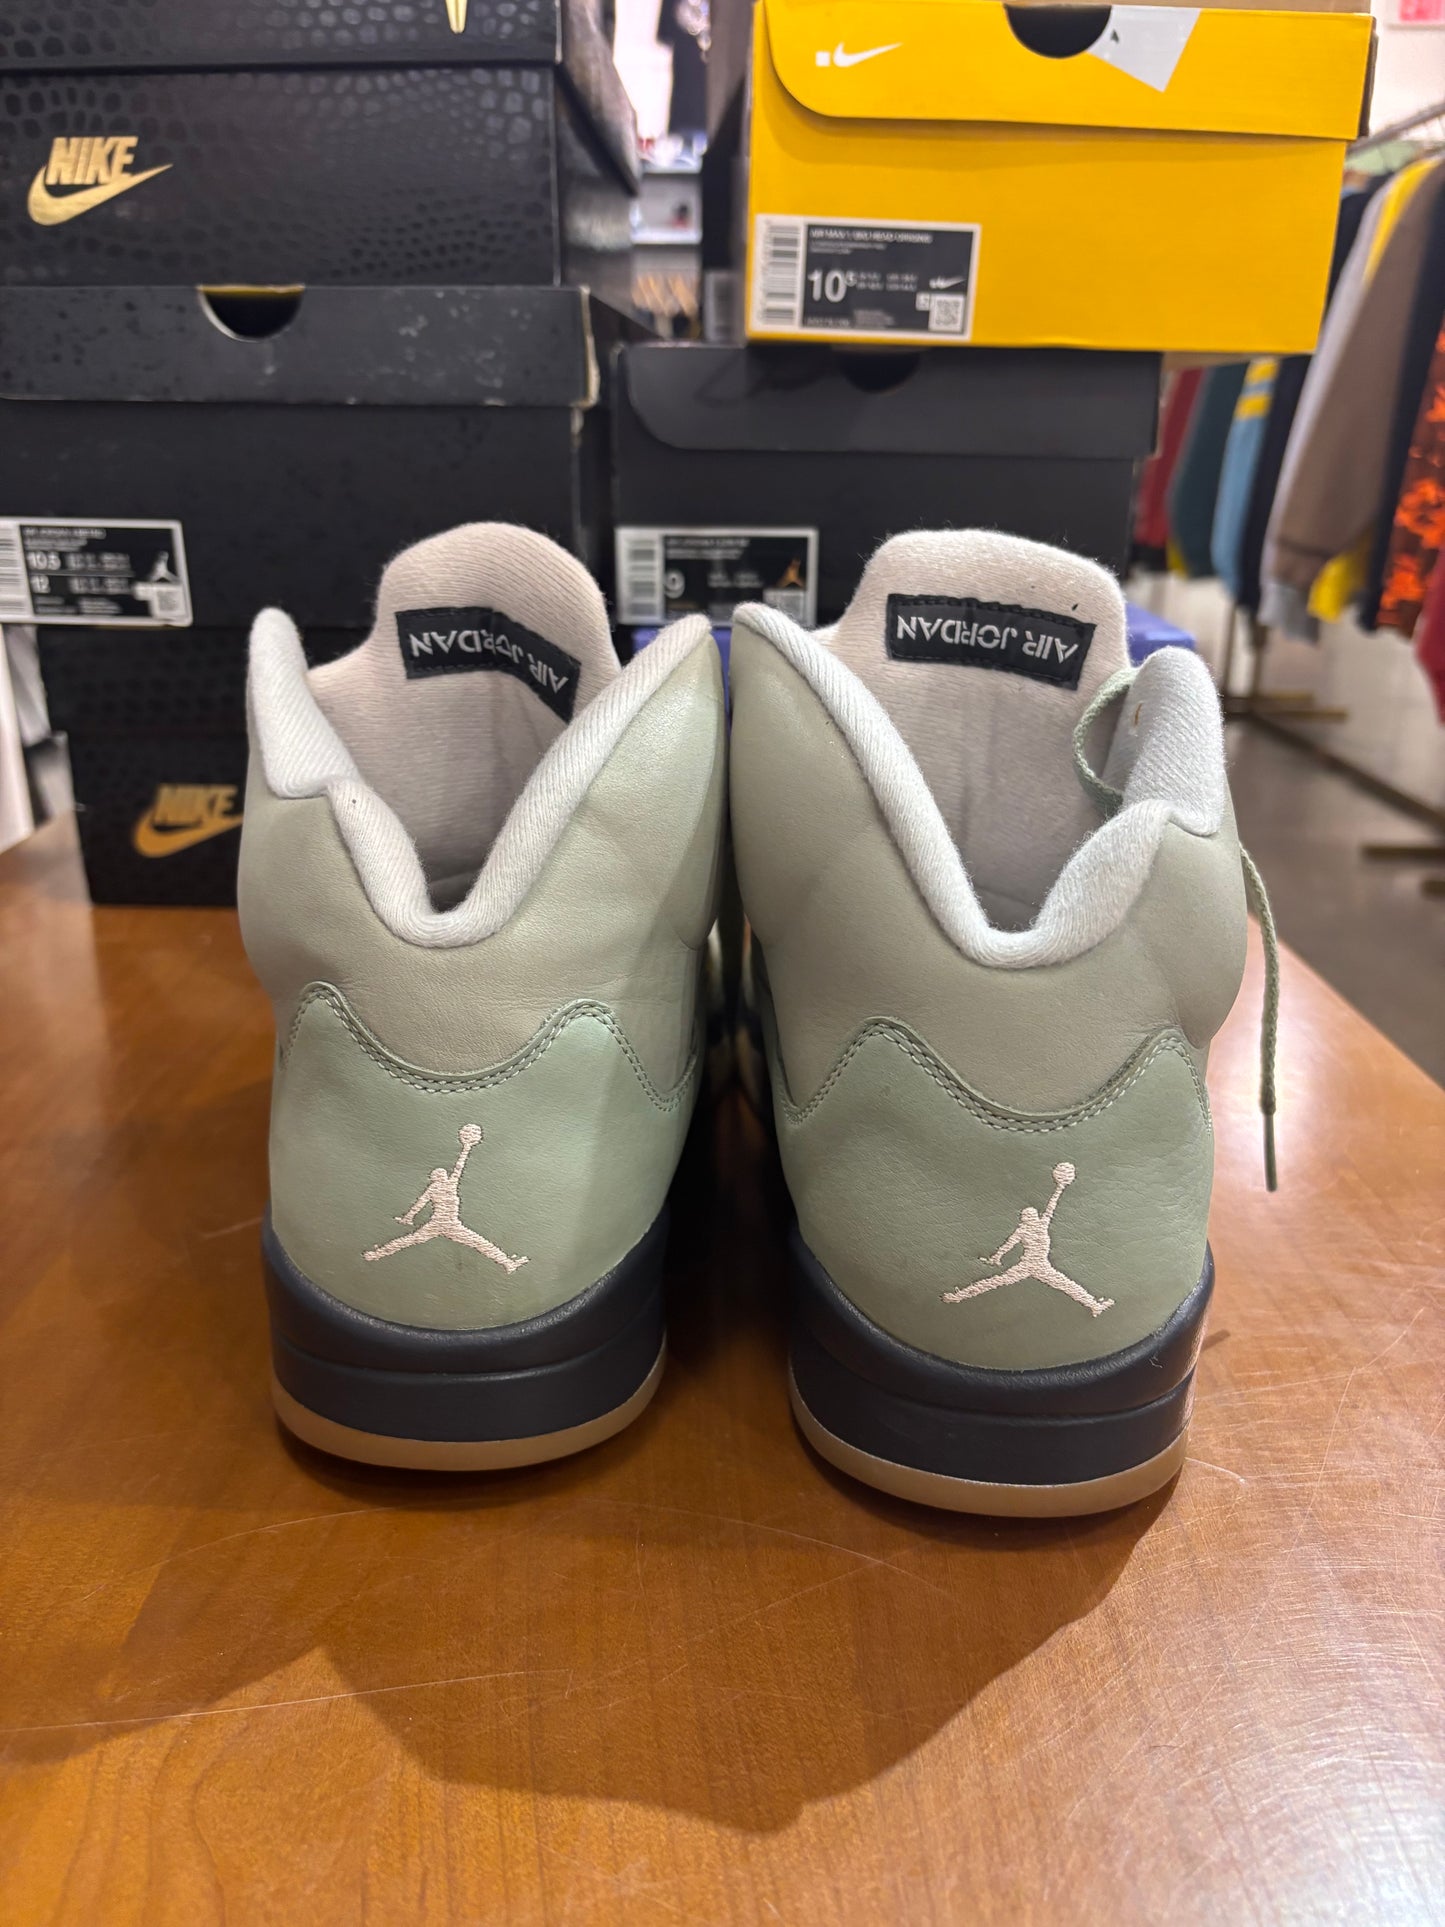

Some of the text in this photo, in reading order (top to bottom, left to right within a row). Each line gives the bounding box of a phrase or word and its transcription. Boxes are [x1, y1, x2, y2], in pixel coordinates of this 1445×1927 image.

[46, 136, 139, 185] NIKE
[409, 629, 568, 693] AIR JORDAN
[897, 615, 1079, 664] AIR JORDAN
[154, 784, 238, 826] NIKE
